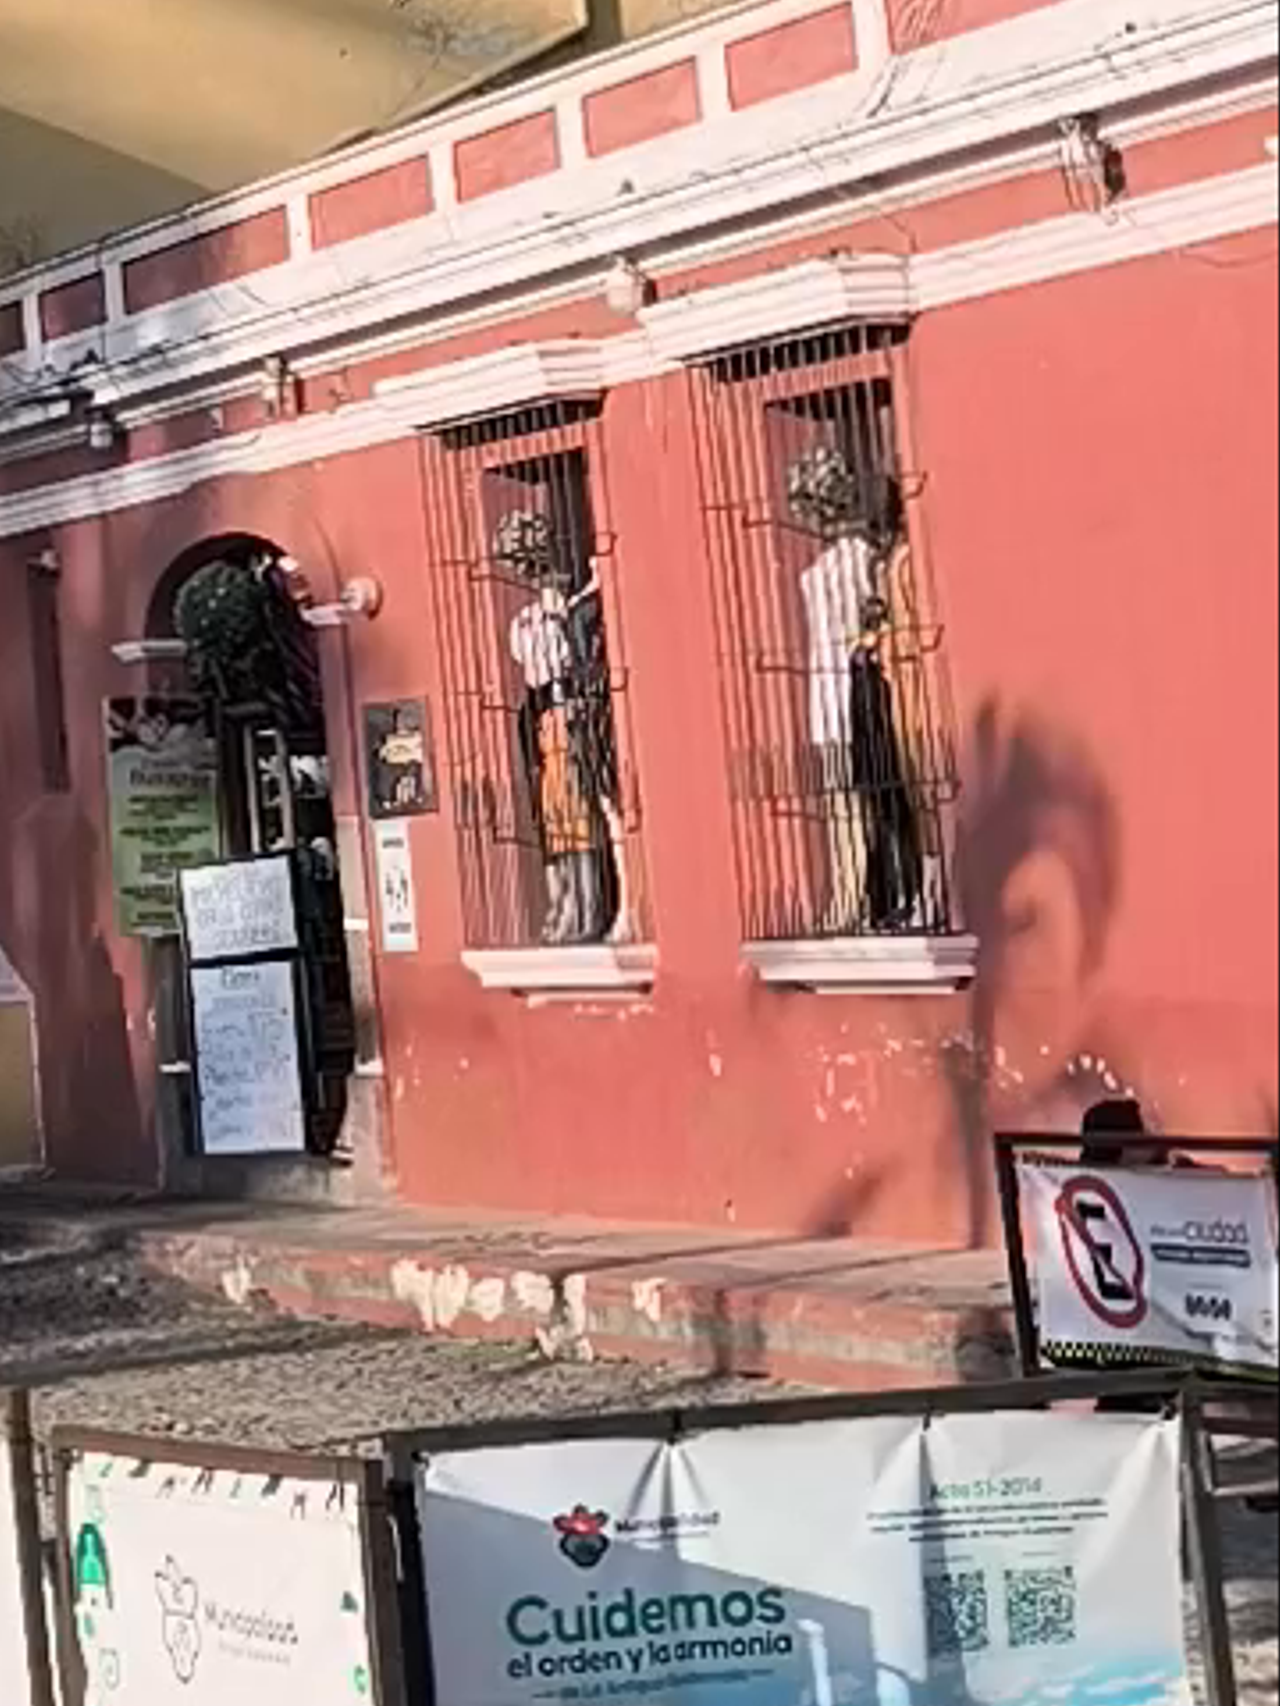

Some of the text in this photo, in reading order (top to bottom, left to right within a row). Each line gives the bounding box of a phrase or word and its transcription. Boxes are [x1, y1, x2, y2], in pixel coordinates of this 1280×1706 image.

[506, 1587, 787, 1647] Cuidemos
[506, 1650, 533, 1679] el
[537, 1648, 623, 1677] orden
[624, 1647, 644, 1674] y
[647, 1639, 672, 1666] la
